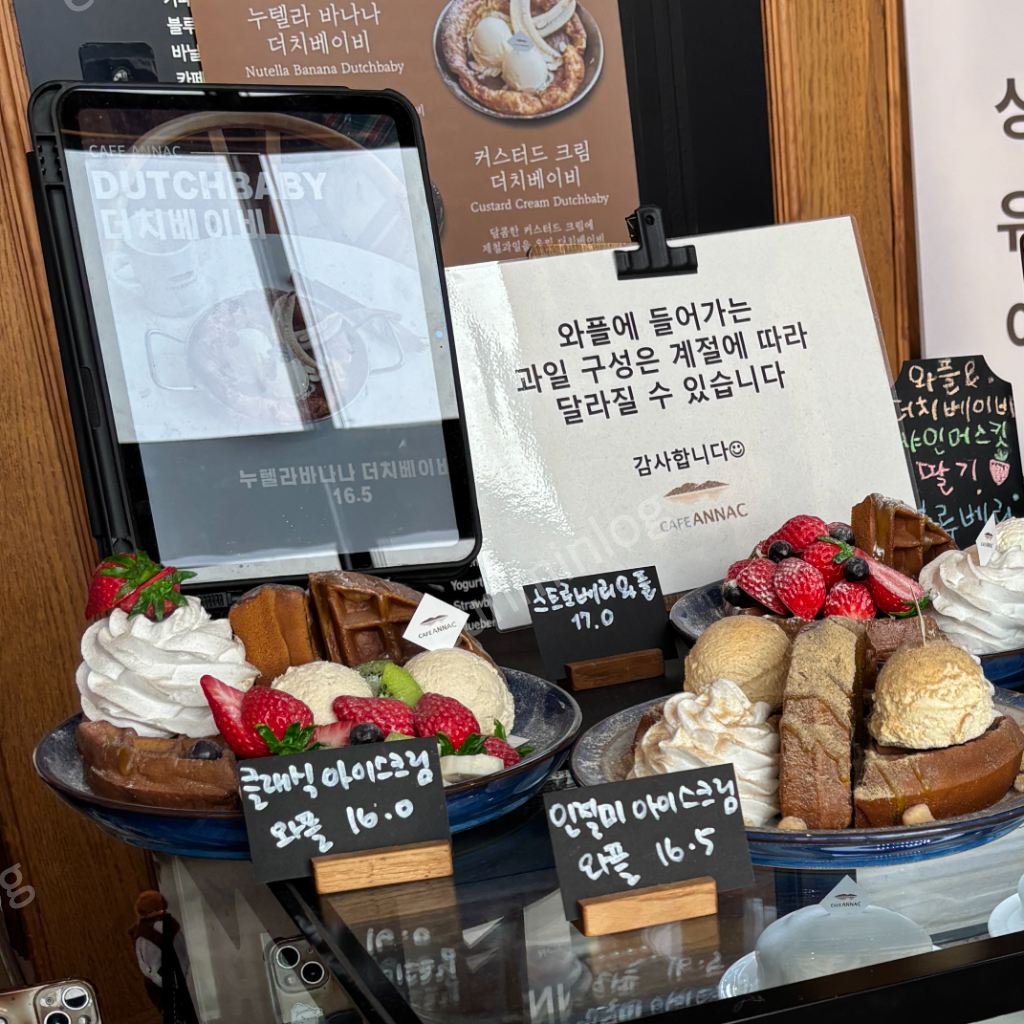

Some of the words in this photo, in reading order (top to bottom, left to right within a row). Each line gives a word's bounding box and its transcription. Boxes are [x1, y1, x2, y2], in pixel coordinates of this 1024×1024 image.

[247, 4, 310, 30] 누텔라
[319, 2, 381, 26] 바나나
[267, 30, 370, 56] 더치베이비
[246, 64, 290, 78] Nutella
[294, 64, 338, 76] Banana
[341, 61, 404, 76] Dutchbaby
[88, 145, 125, 157] CAFE
[131, 145, 181, 157] ANNAC
[474, 143, 548, 168] 커스터드
[555, 140, 590, 163] 크림
[91, 170, 327, 200] DUTCHBABY
[491, 166, 581, 192] 더치베이비
[470, 200, 512, 213] Custard
[515, 198, 550, 210] Cream
[553, 193, 609, 207] Dutchbaby
[100, 208, 266, 240] 더치베이비
[489, 224, 519, 240] 달콤한
[523, 221, 562, 236] 커스터드
[565, 218, 594, 232] 크림에
[558, 311, 639, 349] 와플에
[649, 297, 752, 337] 들어가는
[515, 358, 570, 394] 과일
[581, 345, 660, 385] 구성은
[672, 331, 748, 371] 계절에
[757, 322, 808, 353] 따라
[556, 385, 638, 425] 달라질
[649, 380, 673, 410] 수
[683, 360, 786, 405] 있습니다
[334, 486, 372, 505] 16.5
[571, 608, 615, 630] 17.0
[240, 762, 318, 811] 클래식
[322, 750, 434, 790] 아이스크림
[549, 797, 626, 840] 인절미
[632, 778, 739, 815] 아이스크림
[270, 811, 334, 853] 와플
[346, 799, 414, 835] 16.0
[578, 841, 641, 886] 와플
[655, 827, 715, 866] 16.5
